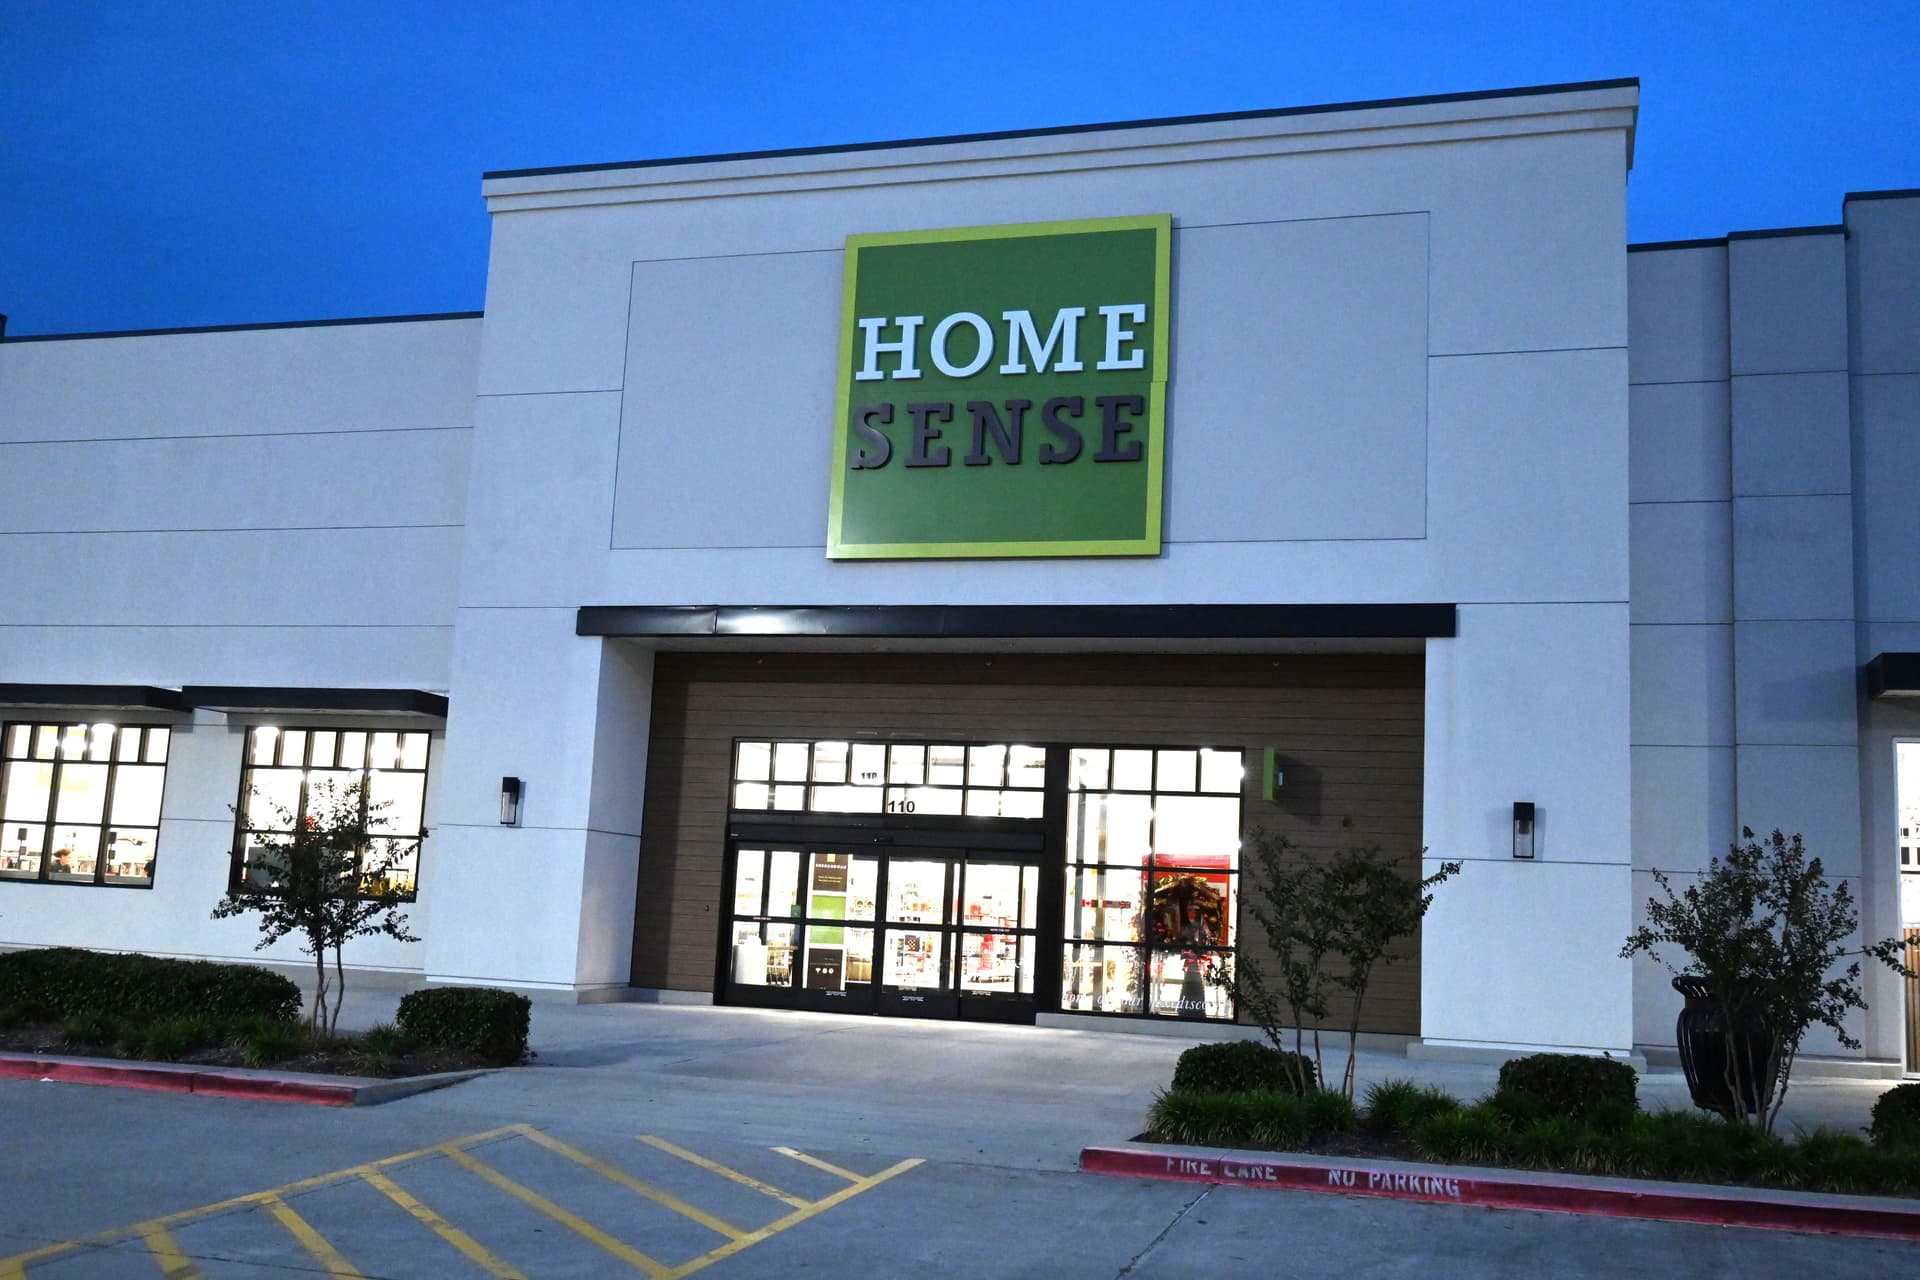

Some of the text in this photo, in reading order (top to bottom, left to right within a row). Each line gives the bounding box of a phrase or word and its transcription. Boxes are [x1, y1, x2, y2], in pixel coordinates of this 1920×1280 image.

[855, 303, 1146, 381] HOME
[850, 395, 1145, 471] SENSE
[888, 800, 915, 813] 110
[1167, 1157, 1460, 1197] FIRE LANE NO PARKING
